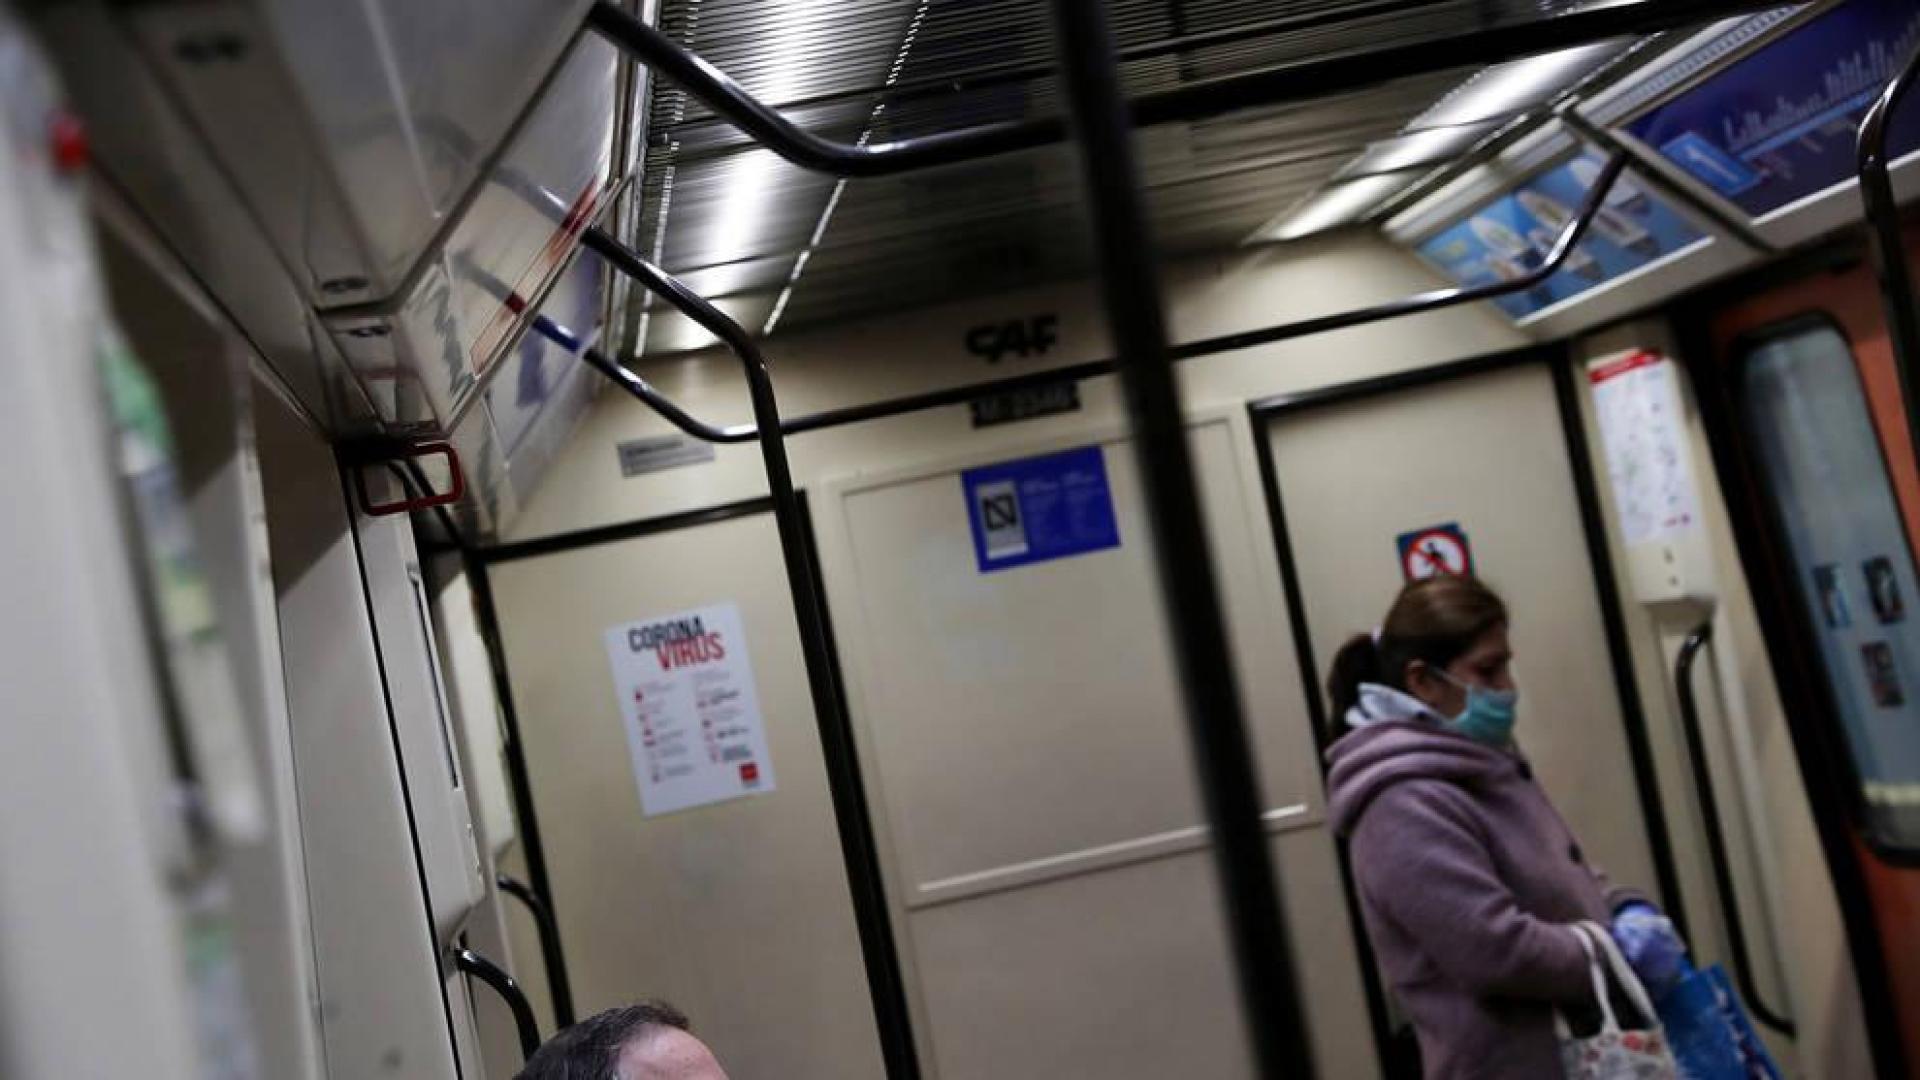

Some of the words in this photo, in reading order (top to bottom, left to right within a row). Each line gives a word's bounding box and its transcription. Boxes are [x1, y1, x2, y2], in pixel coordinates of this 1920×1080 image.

[966, 315, 1057, 363] CAF
[628, 616, 705, 652] CORONA
[656, 632, 725, 671] VIRUS
